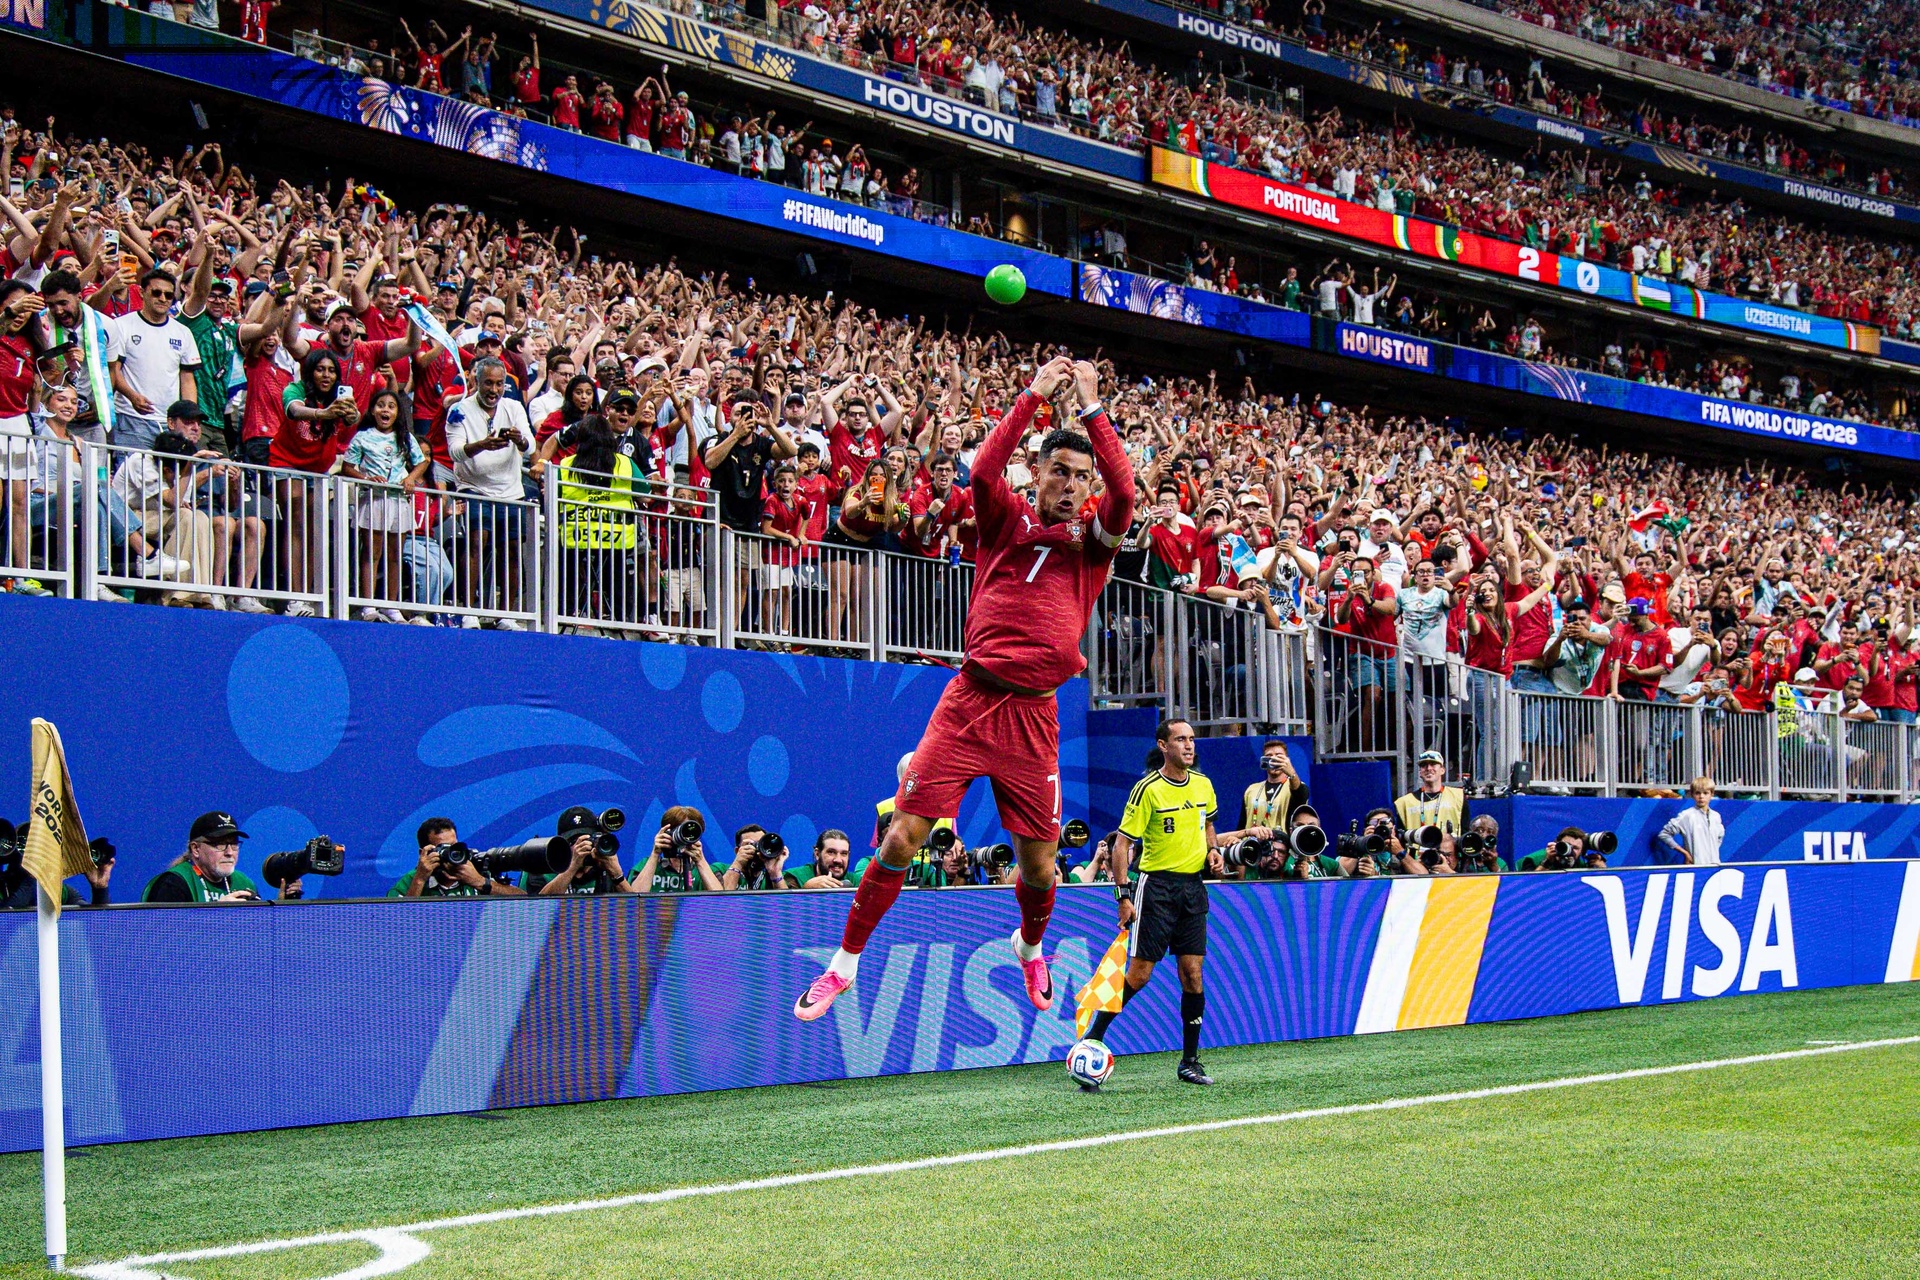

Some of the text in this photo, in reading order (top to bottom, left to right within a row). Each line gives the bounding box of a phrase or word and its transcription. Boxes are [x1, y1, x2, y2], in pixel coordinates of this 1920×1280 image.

[1178, 13, 1281, 58] HOUSTON
[864, 79, 1014, 144] HOUSTON
[1784, 180, 1896, 217] FIFA WORLD CUP 2026
[783, 199, 884, 246] #FIFAWorldCup
[1264, 185, 1811, 335] PORTUGAL 2 0 UZBEKISTAN
[169, 337, 182, 347] UZB
[1342, 328, 1429, 368] HOUSTON
[1701, 400, 1858, 446] FIFA WORLD CUP 2026
[742, 469, 751, 487] 7
[809, 501, 817, 519] 7
[1025, 545, 1052, 584] 7
[1628, 651, 1638, 665] 7
[1047, 773, 1060, 815] 7
[35, 802, 63, 845] 202
[1803, 831, 1867, 861] FIFA
[1580, 868, 1799, 1004] VISA
[793, 936, 1098, 1078] VISA
